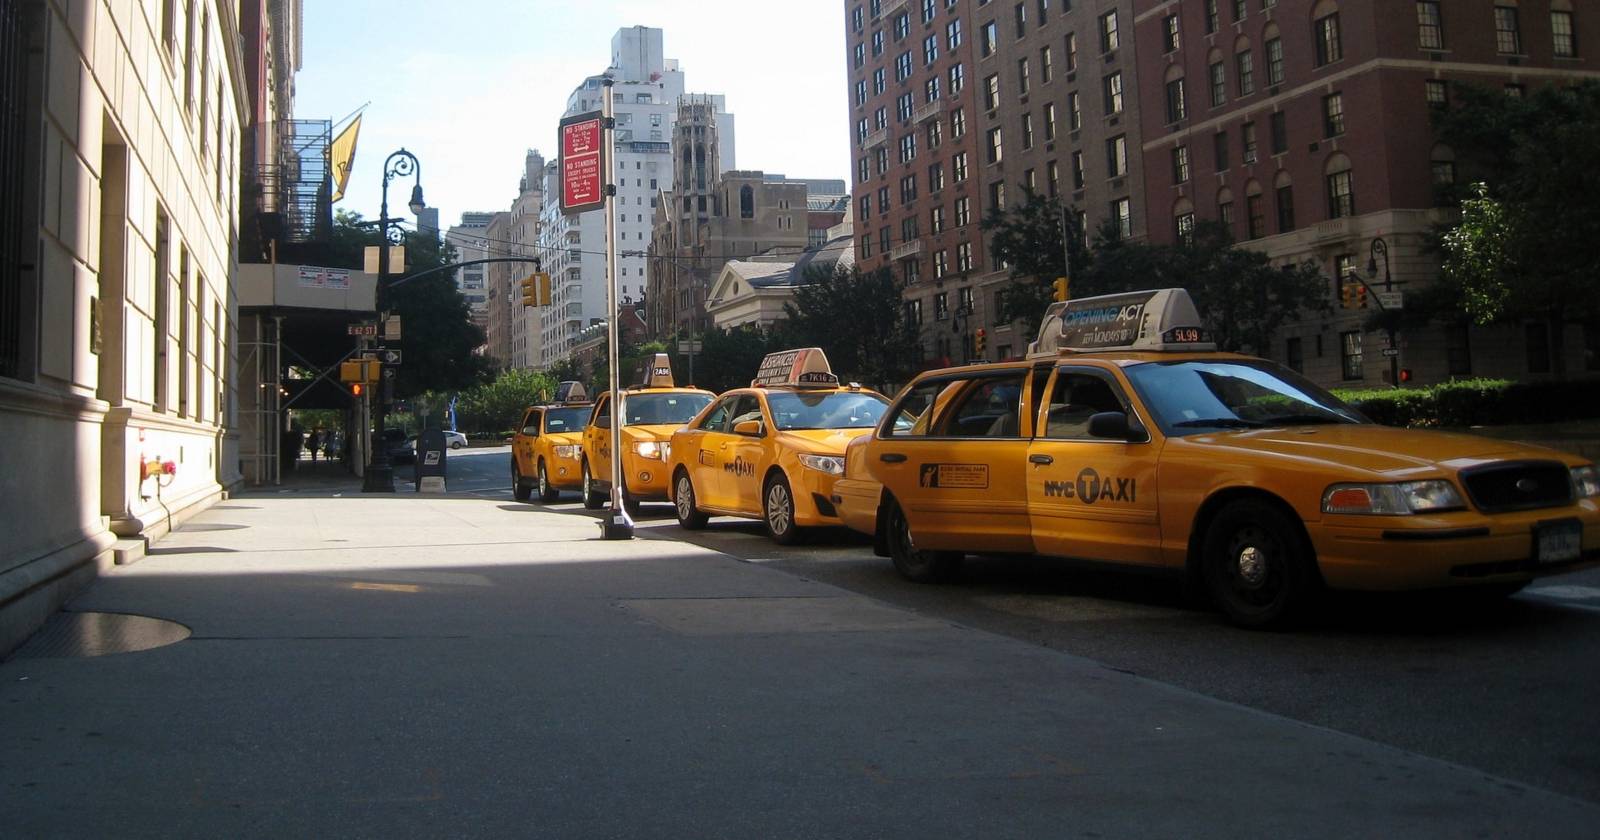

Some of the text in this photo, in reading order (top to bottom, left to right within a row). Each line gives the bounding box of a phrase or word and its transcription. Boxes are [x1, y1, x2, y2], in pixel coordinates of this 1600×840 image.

[574, 121, 596, 132] STANDING
[574, 158, 597, 168] STANDING
[1064, 307, 1118, 327] OPENING
[1115, 304, 1144, 322] ACT
[366, 326, 374, 334] ST
[1175, 329, 1198, 342] 5L99
[809, 373, 827, 381] 7K16
[734, 456, 755, 478] TAXI
[1043, 471, 1136, 503] NYC TAXI
